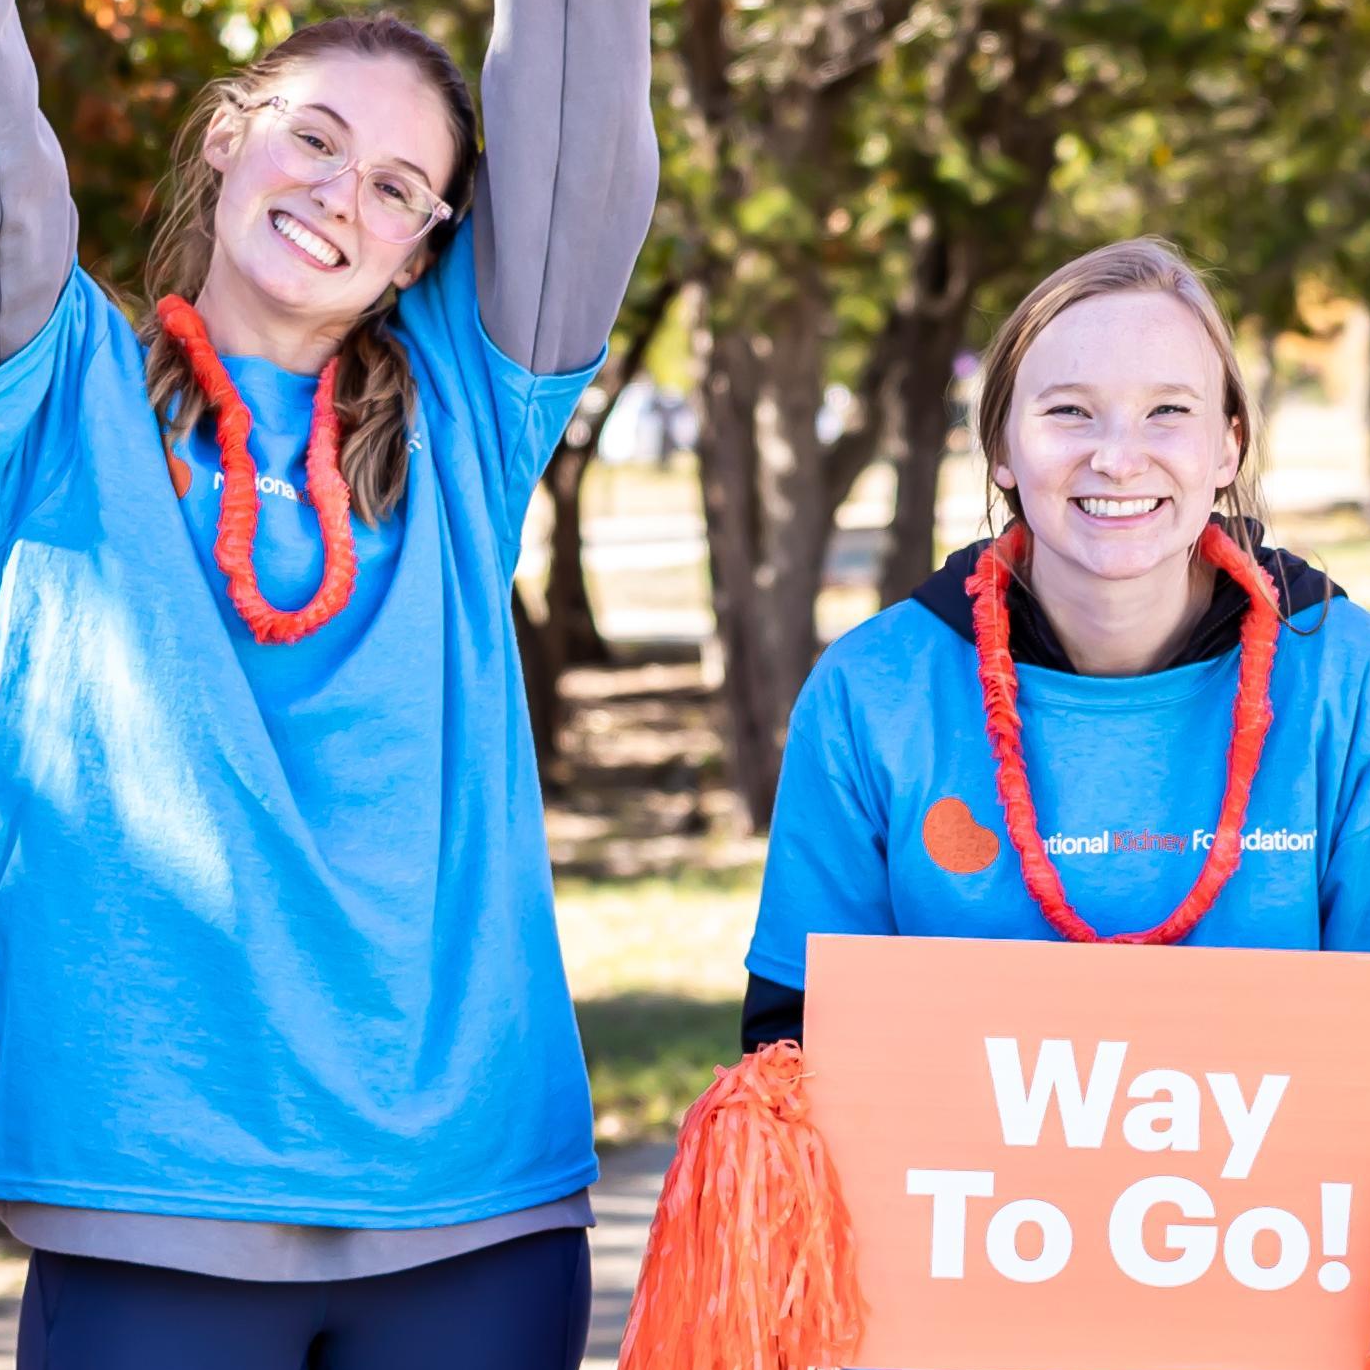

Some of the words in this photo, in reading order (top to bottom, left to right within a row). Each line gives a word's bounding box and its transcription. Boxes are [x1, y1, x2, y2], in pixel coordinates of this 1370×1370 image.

[1114, 829, 1188, 854] Kidney
[1192, 828, 1315, 851] Fodation
[984, 1036, 1291, 1180] Way
[906, 1168, 1073, 1283] To
[1108, 1176, 1353, 1292] Go!
